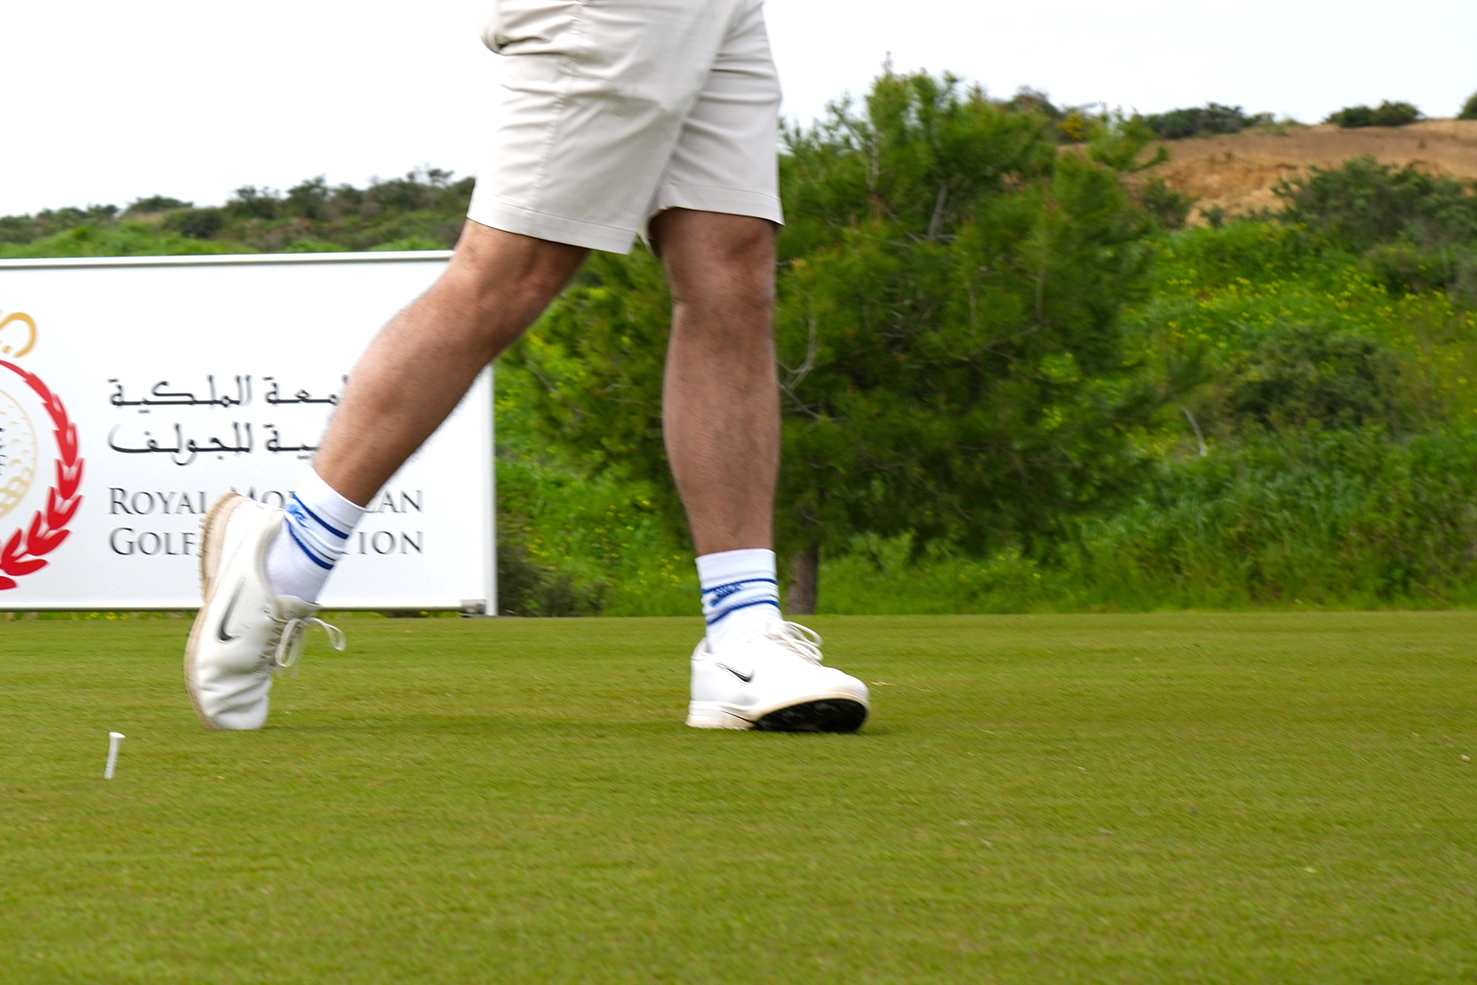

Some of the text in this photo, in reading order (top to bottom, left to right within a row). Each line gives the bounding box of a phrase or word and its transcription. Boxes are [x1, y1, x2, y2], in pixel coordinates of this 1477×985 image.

[107, 374, 253, 414] الملكية
[107, 421, 253, 466] للجولف
[109, 527, 196, 556] GOLF
